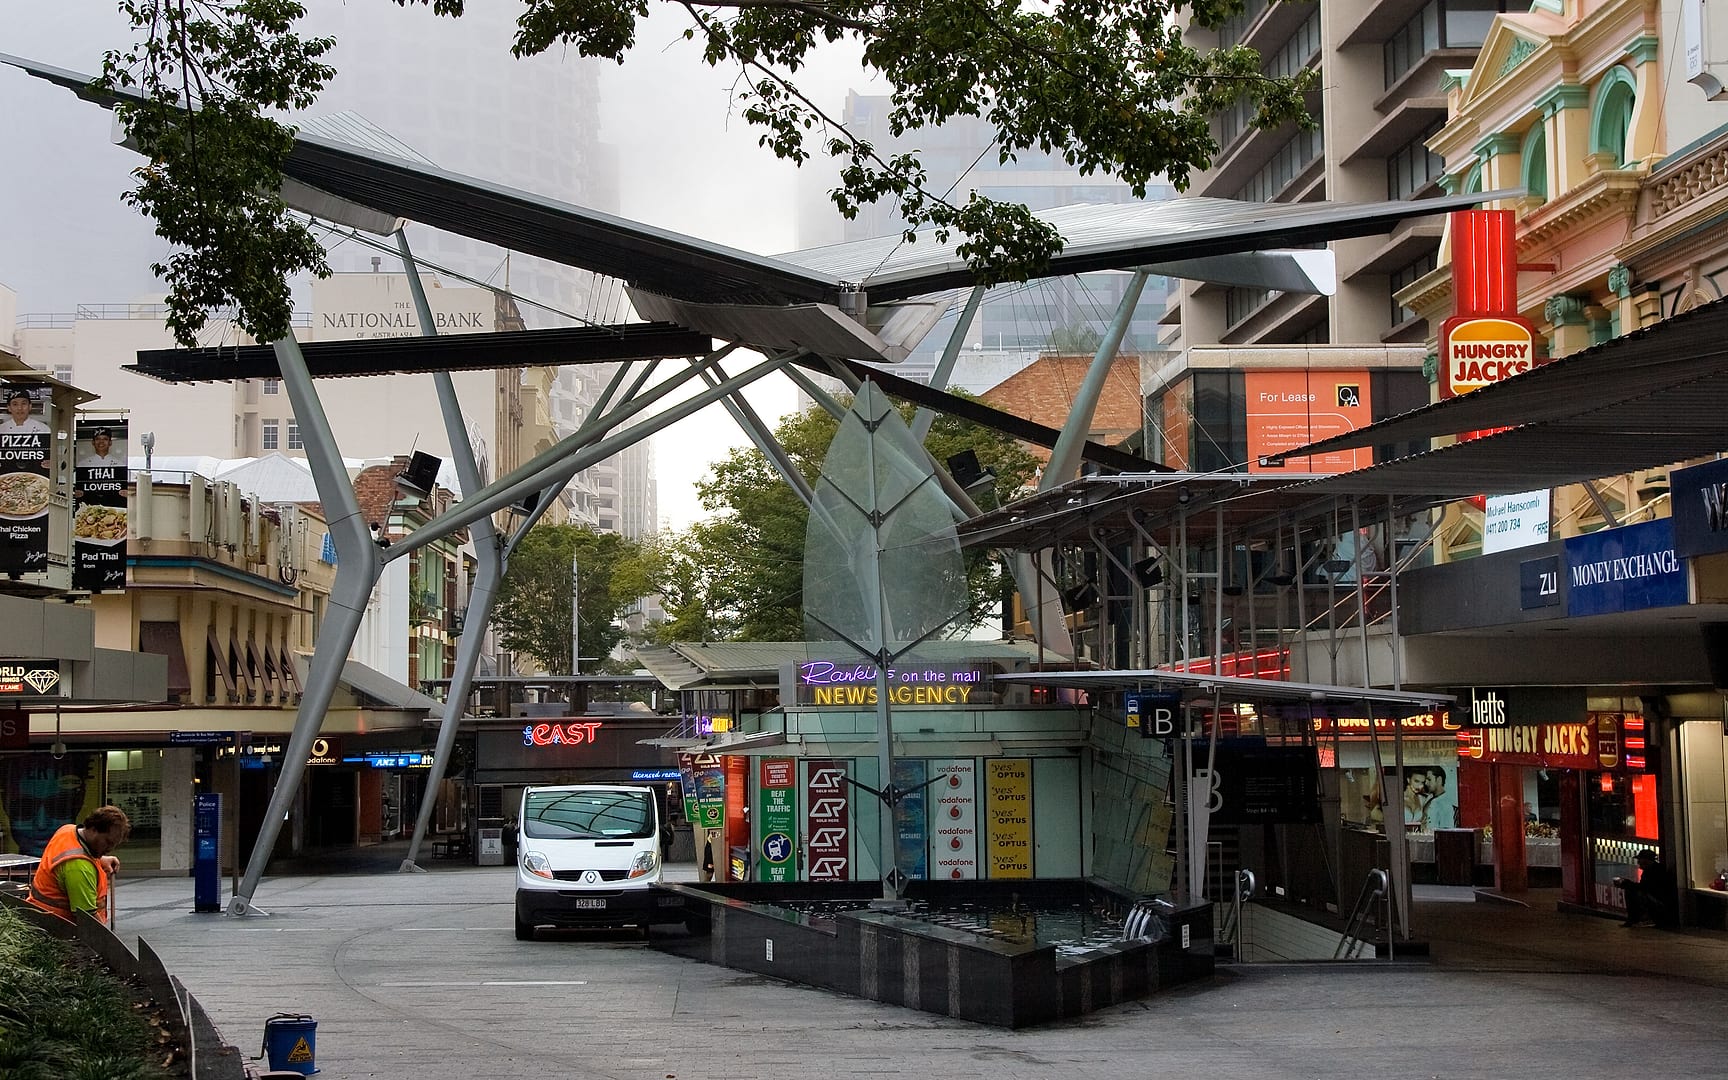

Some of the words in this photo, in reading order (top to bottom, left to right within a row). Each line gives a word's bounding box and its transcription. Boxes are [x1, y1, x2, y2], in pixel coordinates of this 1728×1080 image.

[323, 313, 416, 328] NATIONAL
[437, 312, 484, 328] BANK
[1454, 344, 1528, 358] HUNGRY
[1454, 360, 1528, 382] JACK'S
[1260, 392, 1278, 402] For
[1282, 392, 1316, 402] Lease
[2, 435, 41, 447] PIZZA
[88, 468, 114, 479] THAI
[1498, 520, 1508, 532] 200
[1510, 518, 1520, 530] 734
[1572, 560, 1612, 587] MONEY
[1614, 550, 1680, 581] EXCHANGE
[902, 671, 918, 682] on
[924, 670, 946, 682] the
[952, 671, 980, 682] mall
[1472, 688, 1505, 724] betts
[0, 720, 16, 736] S
[1156, 708, 1172, 734] B
[1488, 726, 1538, 753] HUNGRY
[1544, 725, 1590, 756] JACK'S
